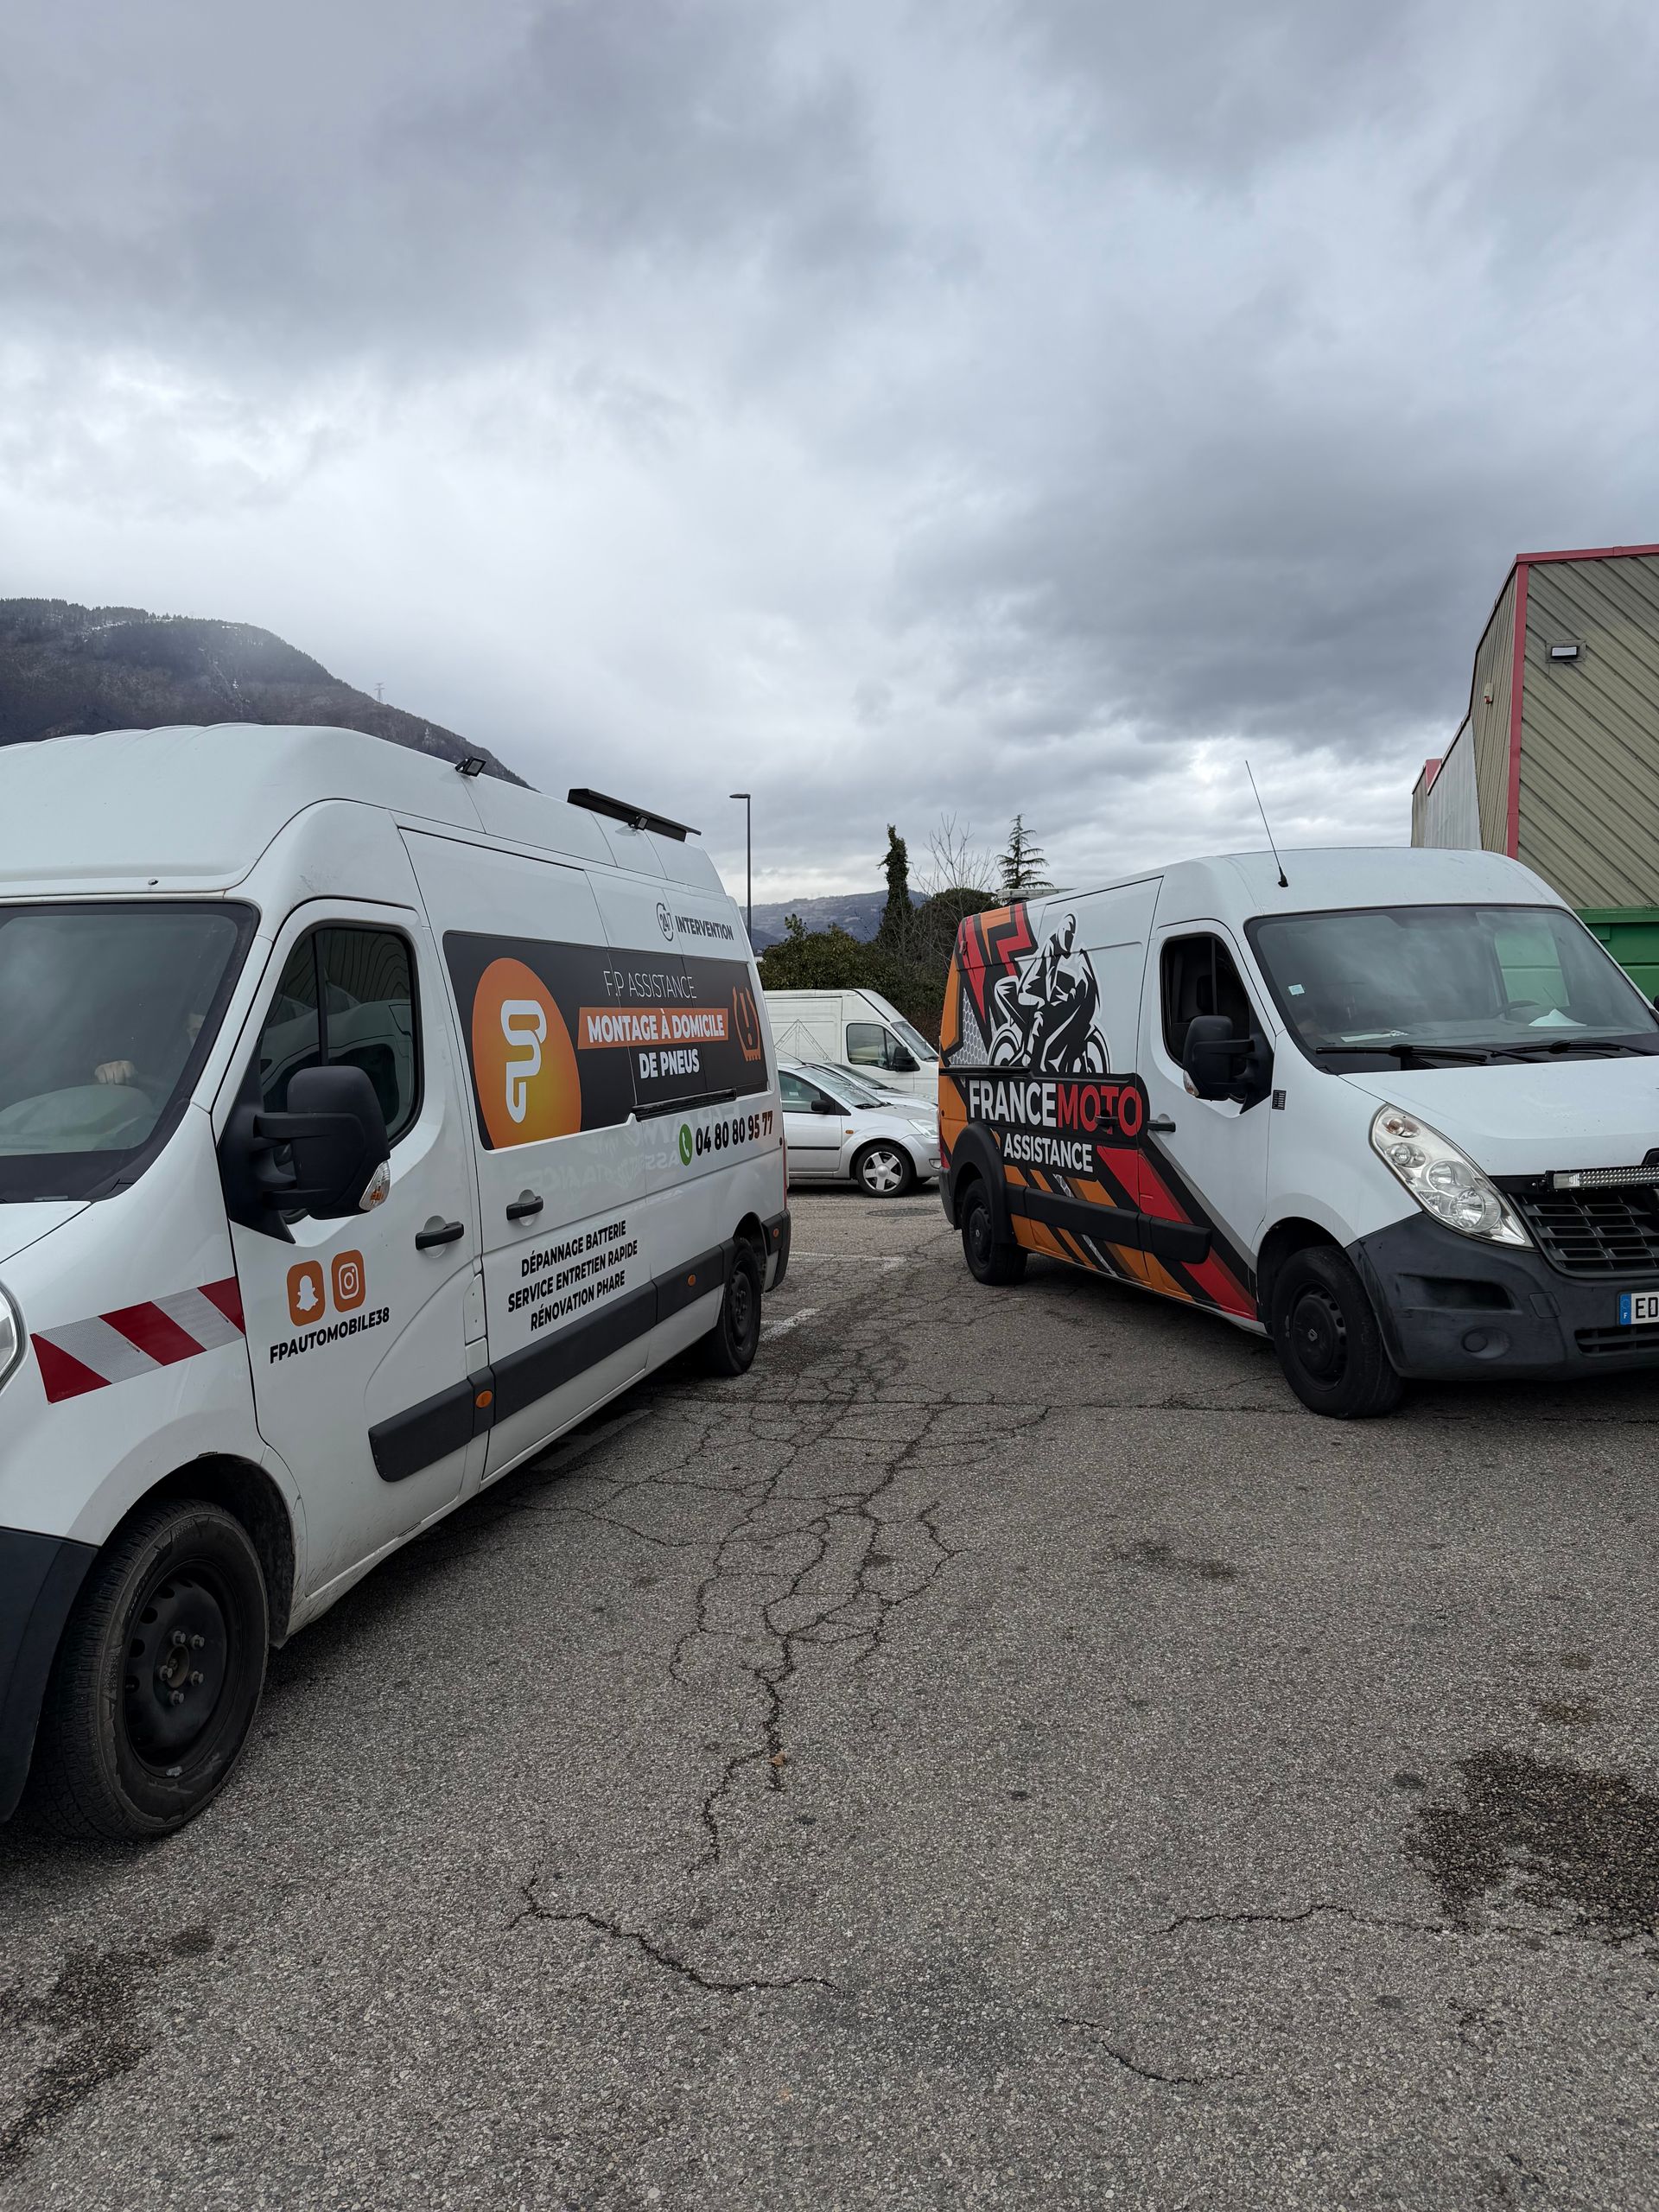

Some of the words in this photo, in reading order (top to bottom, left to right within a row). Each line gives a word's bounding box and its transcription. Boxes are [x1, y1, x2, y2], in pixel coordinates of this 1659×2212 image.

[674, 915, 734, 941] INTERVENTION
[628, 972, 697, 999] ASSISTANCE
[587, 1014, 659, 1044] MONTAGE
[660, 1007, 671, 1039] À
[671, 1014, 725, 1039] DOMICILE
[639, 1052, 658, 1079] DE
[660, 1048, 700, 1077] PNEUS
[696, 1127, 712, 1156] 04
[715, 1122, 729, 1151] 80
[732, 1117, 746, 1146] 80
[747, 1114, 760, 1141] 95
[761, 1109, 773, 1137] 77
[1003, 1132, 1094, 1173] ASSISTANCE
[521, 1236, 584, 1278] DÉPANNAGE
[586, 1219, 626, 1251] BATTERIE
[508, 1275, 554, 1313] SERVICE
[556, 1253, 607, 1291] ENTRETIEN
[607, 1239, 638, 1268] RAPIDE
[531, 1284, 594, 1332] RÉNOVATION
[596, 1269, 626, 1299] PHARE
[270, 1306, 391, 1364] FPAUTOMOBILE38
